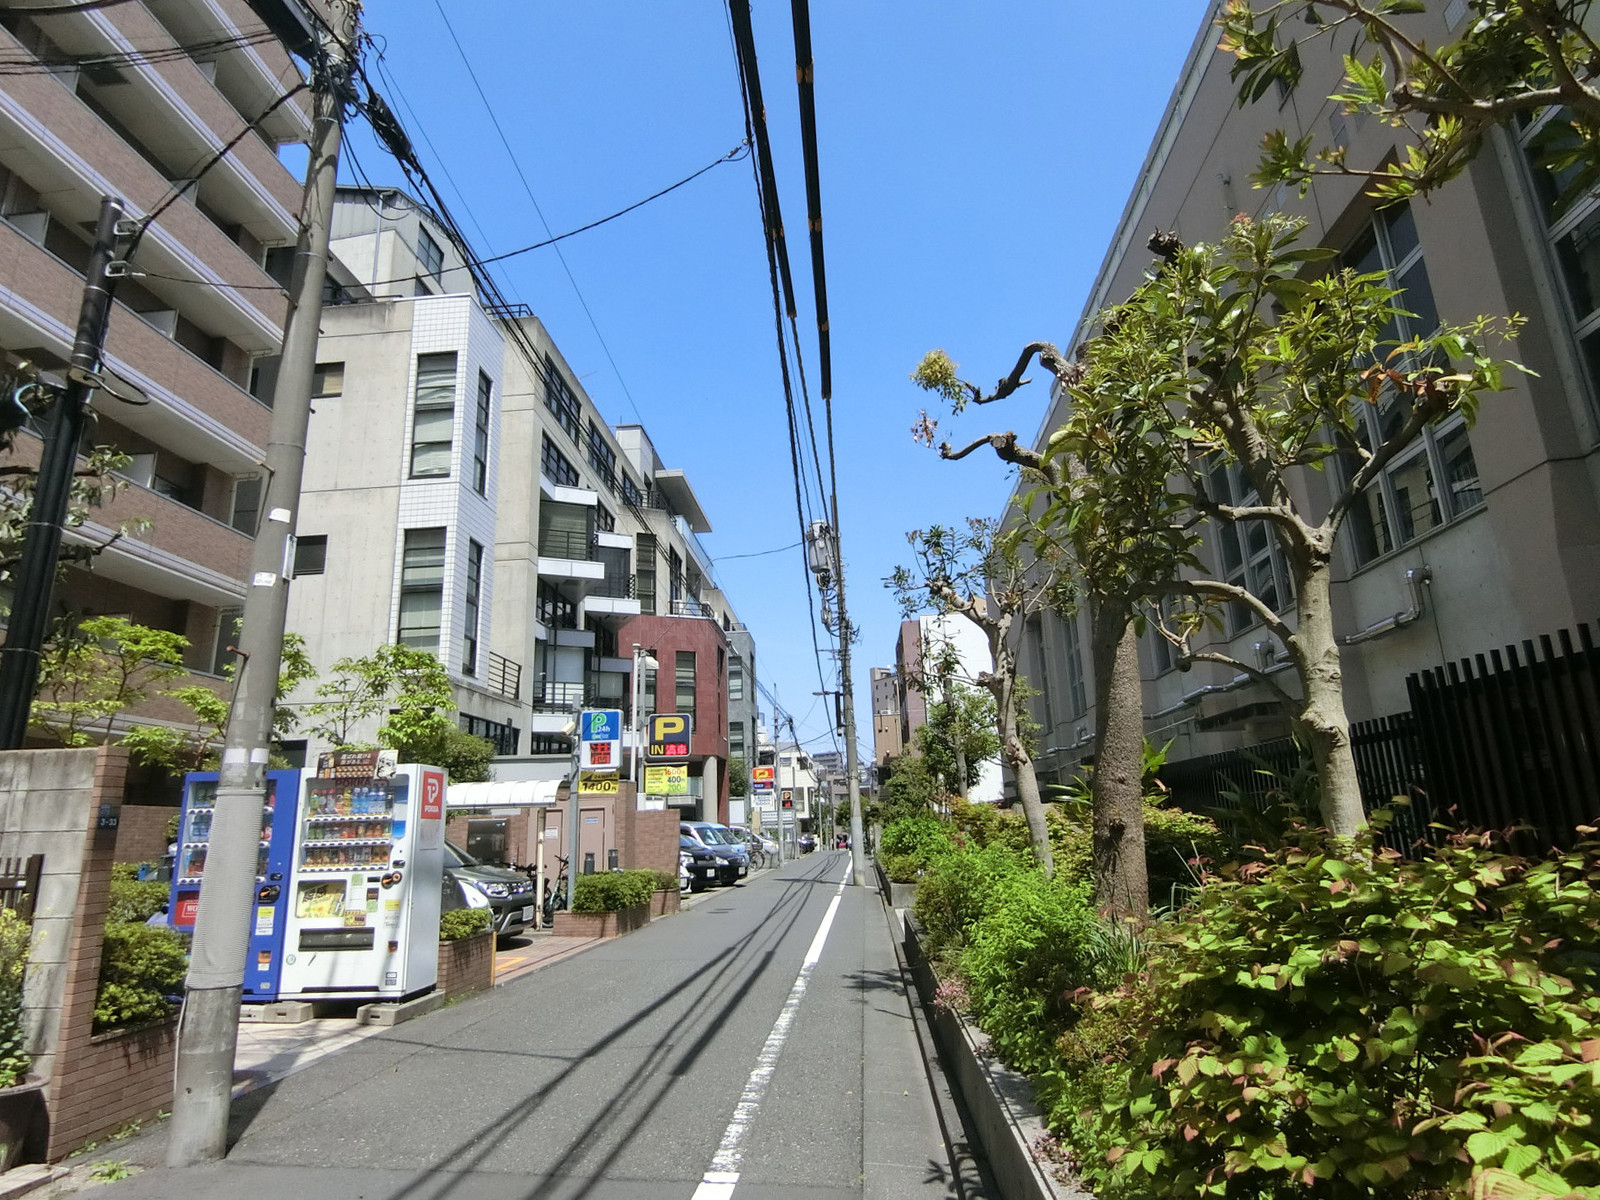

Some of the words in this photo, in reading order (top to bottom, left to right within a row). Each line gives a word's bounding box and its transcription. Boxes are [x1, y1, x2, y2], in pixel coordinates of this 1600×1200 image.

[590, 712, 607, 733] P
[655, 716, 685, 741] P
[590, 743, 611, 765] 満
[651, 744, 664, 755] IN
[665, 744, 688, 756] 満車
[582, 781, 617, 792] 1400円
[667, 775, 685, 784] 400円
